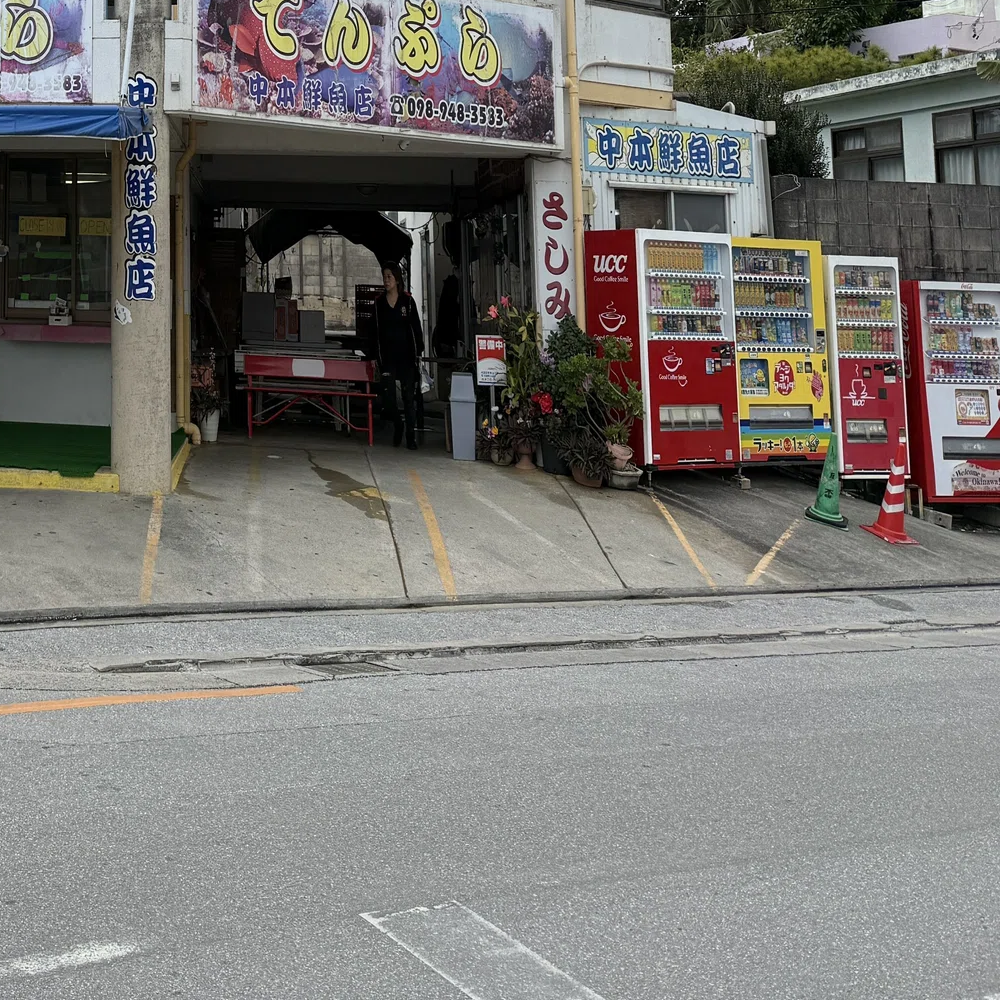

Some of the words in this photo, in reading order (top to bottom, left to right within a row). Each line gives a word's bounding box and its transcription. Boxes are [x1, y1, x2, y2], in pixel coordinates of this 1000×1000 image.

[249, 72, 373, 119] 中本鮮魚店
[407, 96, 504, 127] 098-948-3583
[597, 123, 741, 178] 中本鮮魚店
[542, 191, 571, 320] さしみ
